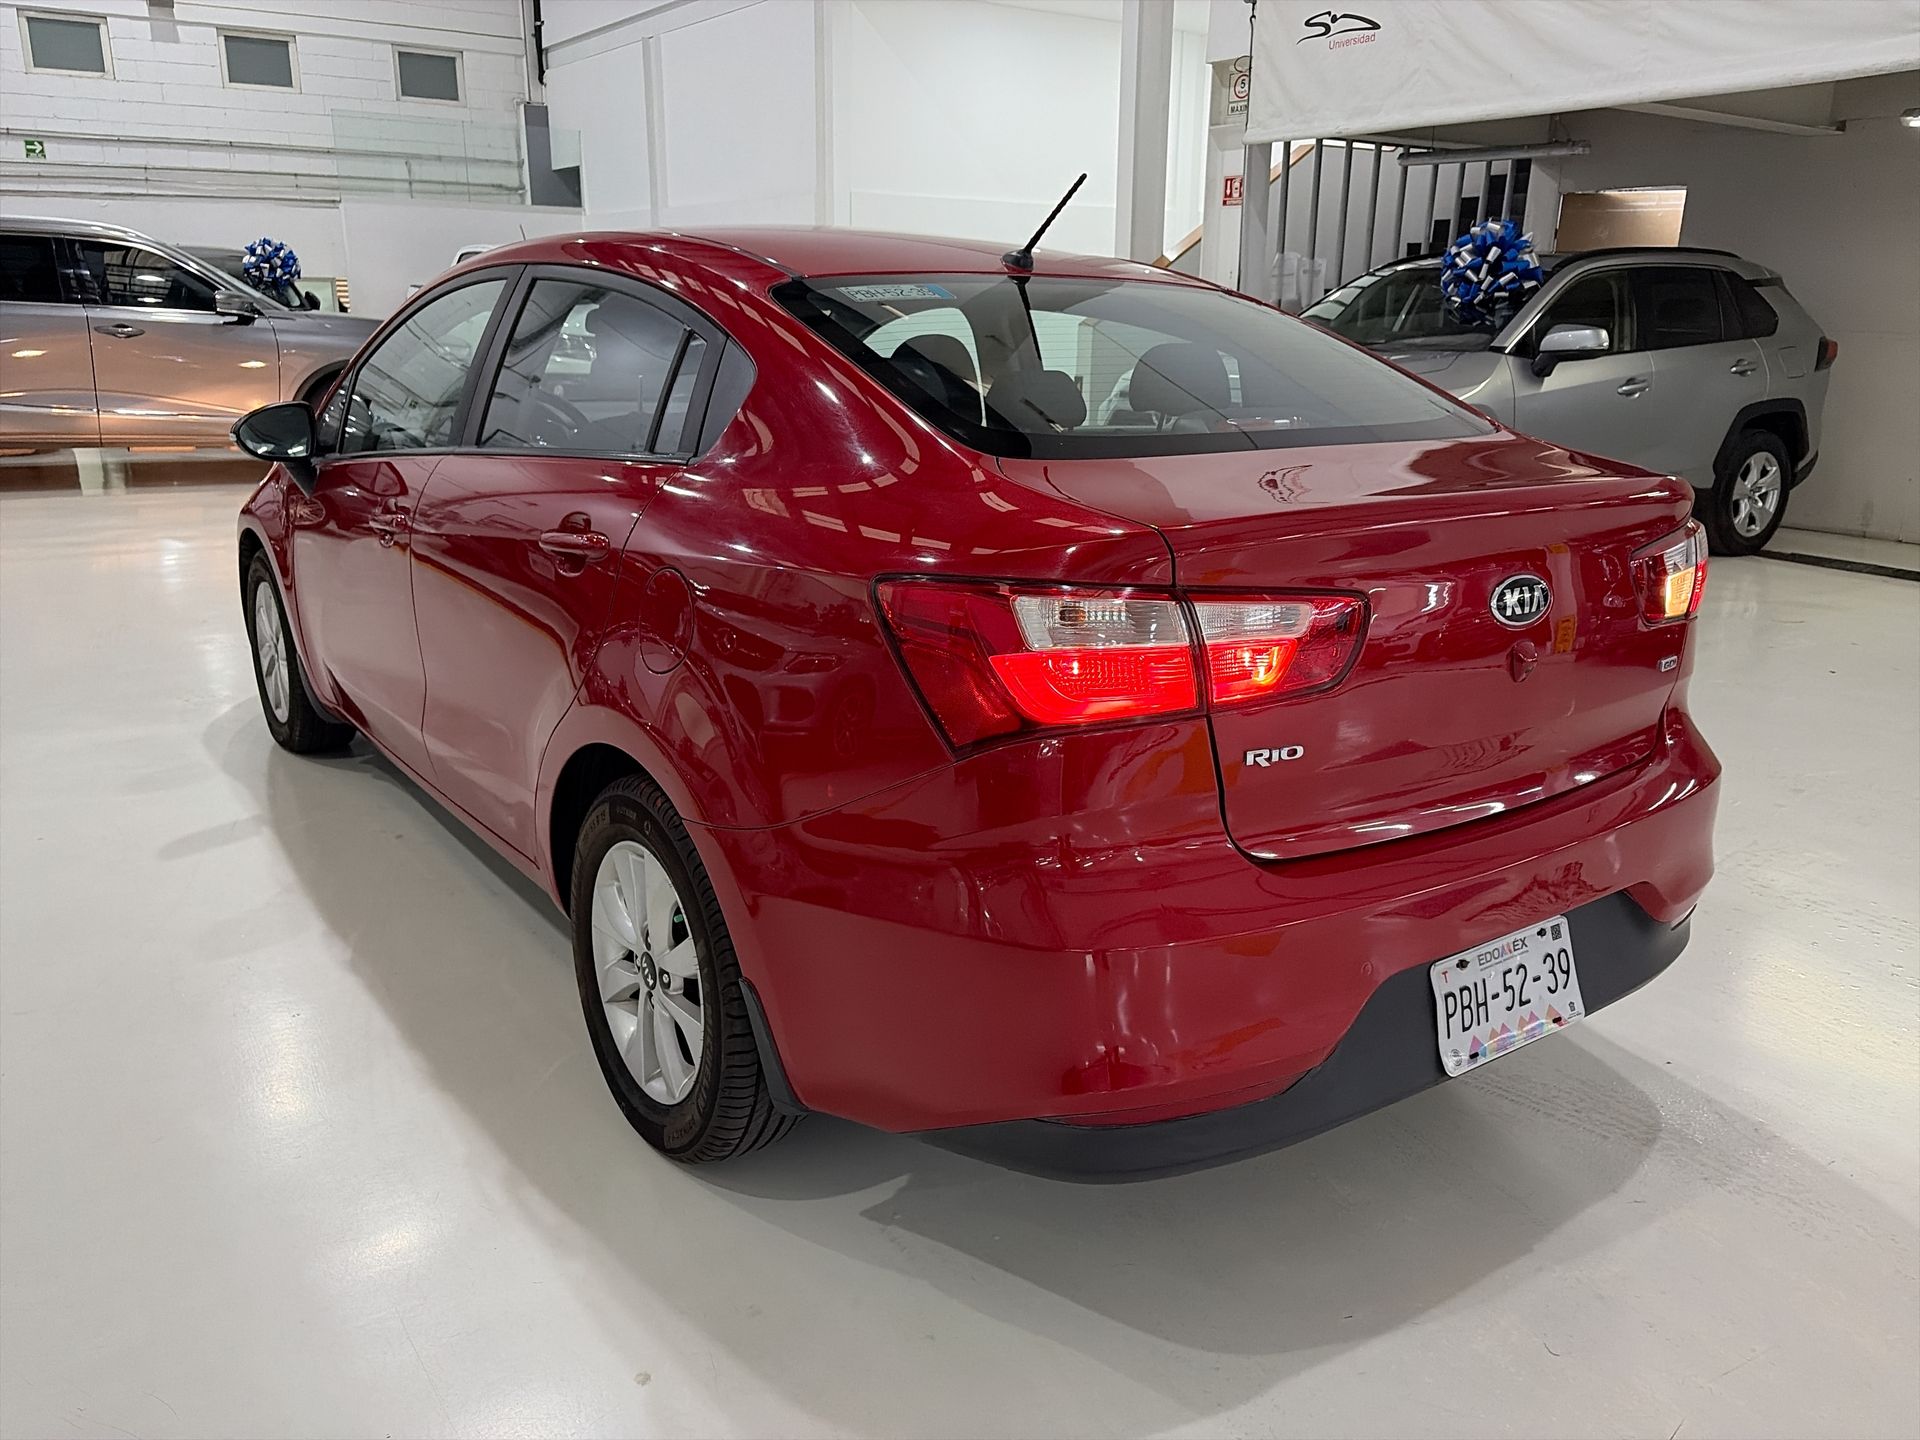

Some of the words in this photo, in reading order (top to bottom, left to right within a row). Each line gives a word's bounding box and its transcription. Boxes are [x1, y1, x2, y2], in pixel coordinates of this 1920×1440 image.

[1328, 32, 1376, 50] Universidad
[1240, 79, 1246, 89] 5
[1503, 584, 1546, 617] KIA
[1245, 745, 1304, 768] RIO
[1443, 947, 1571, 1040] PBH-52-39
